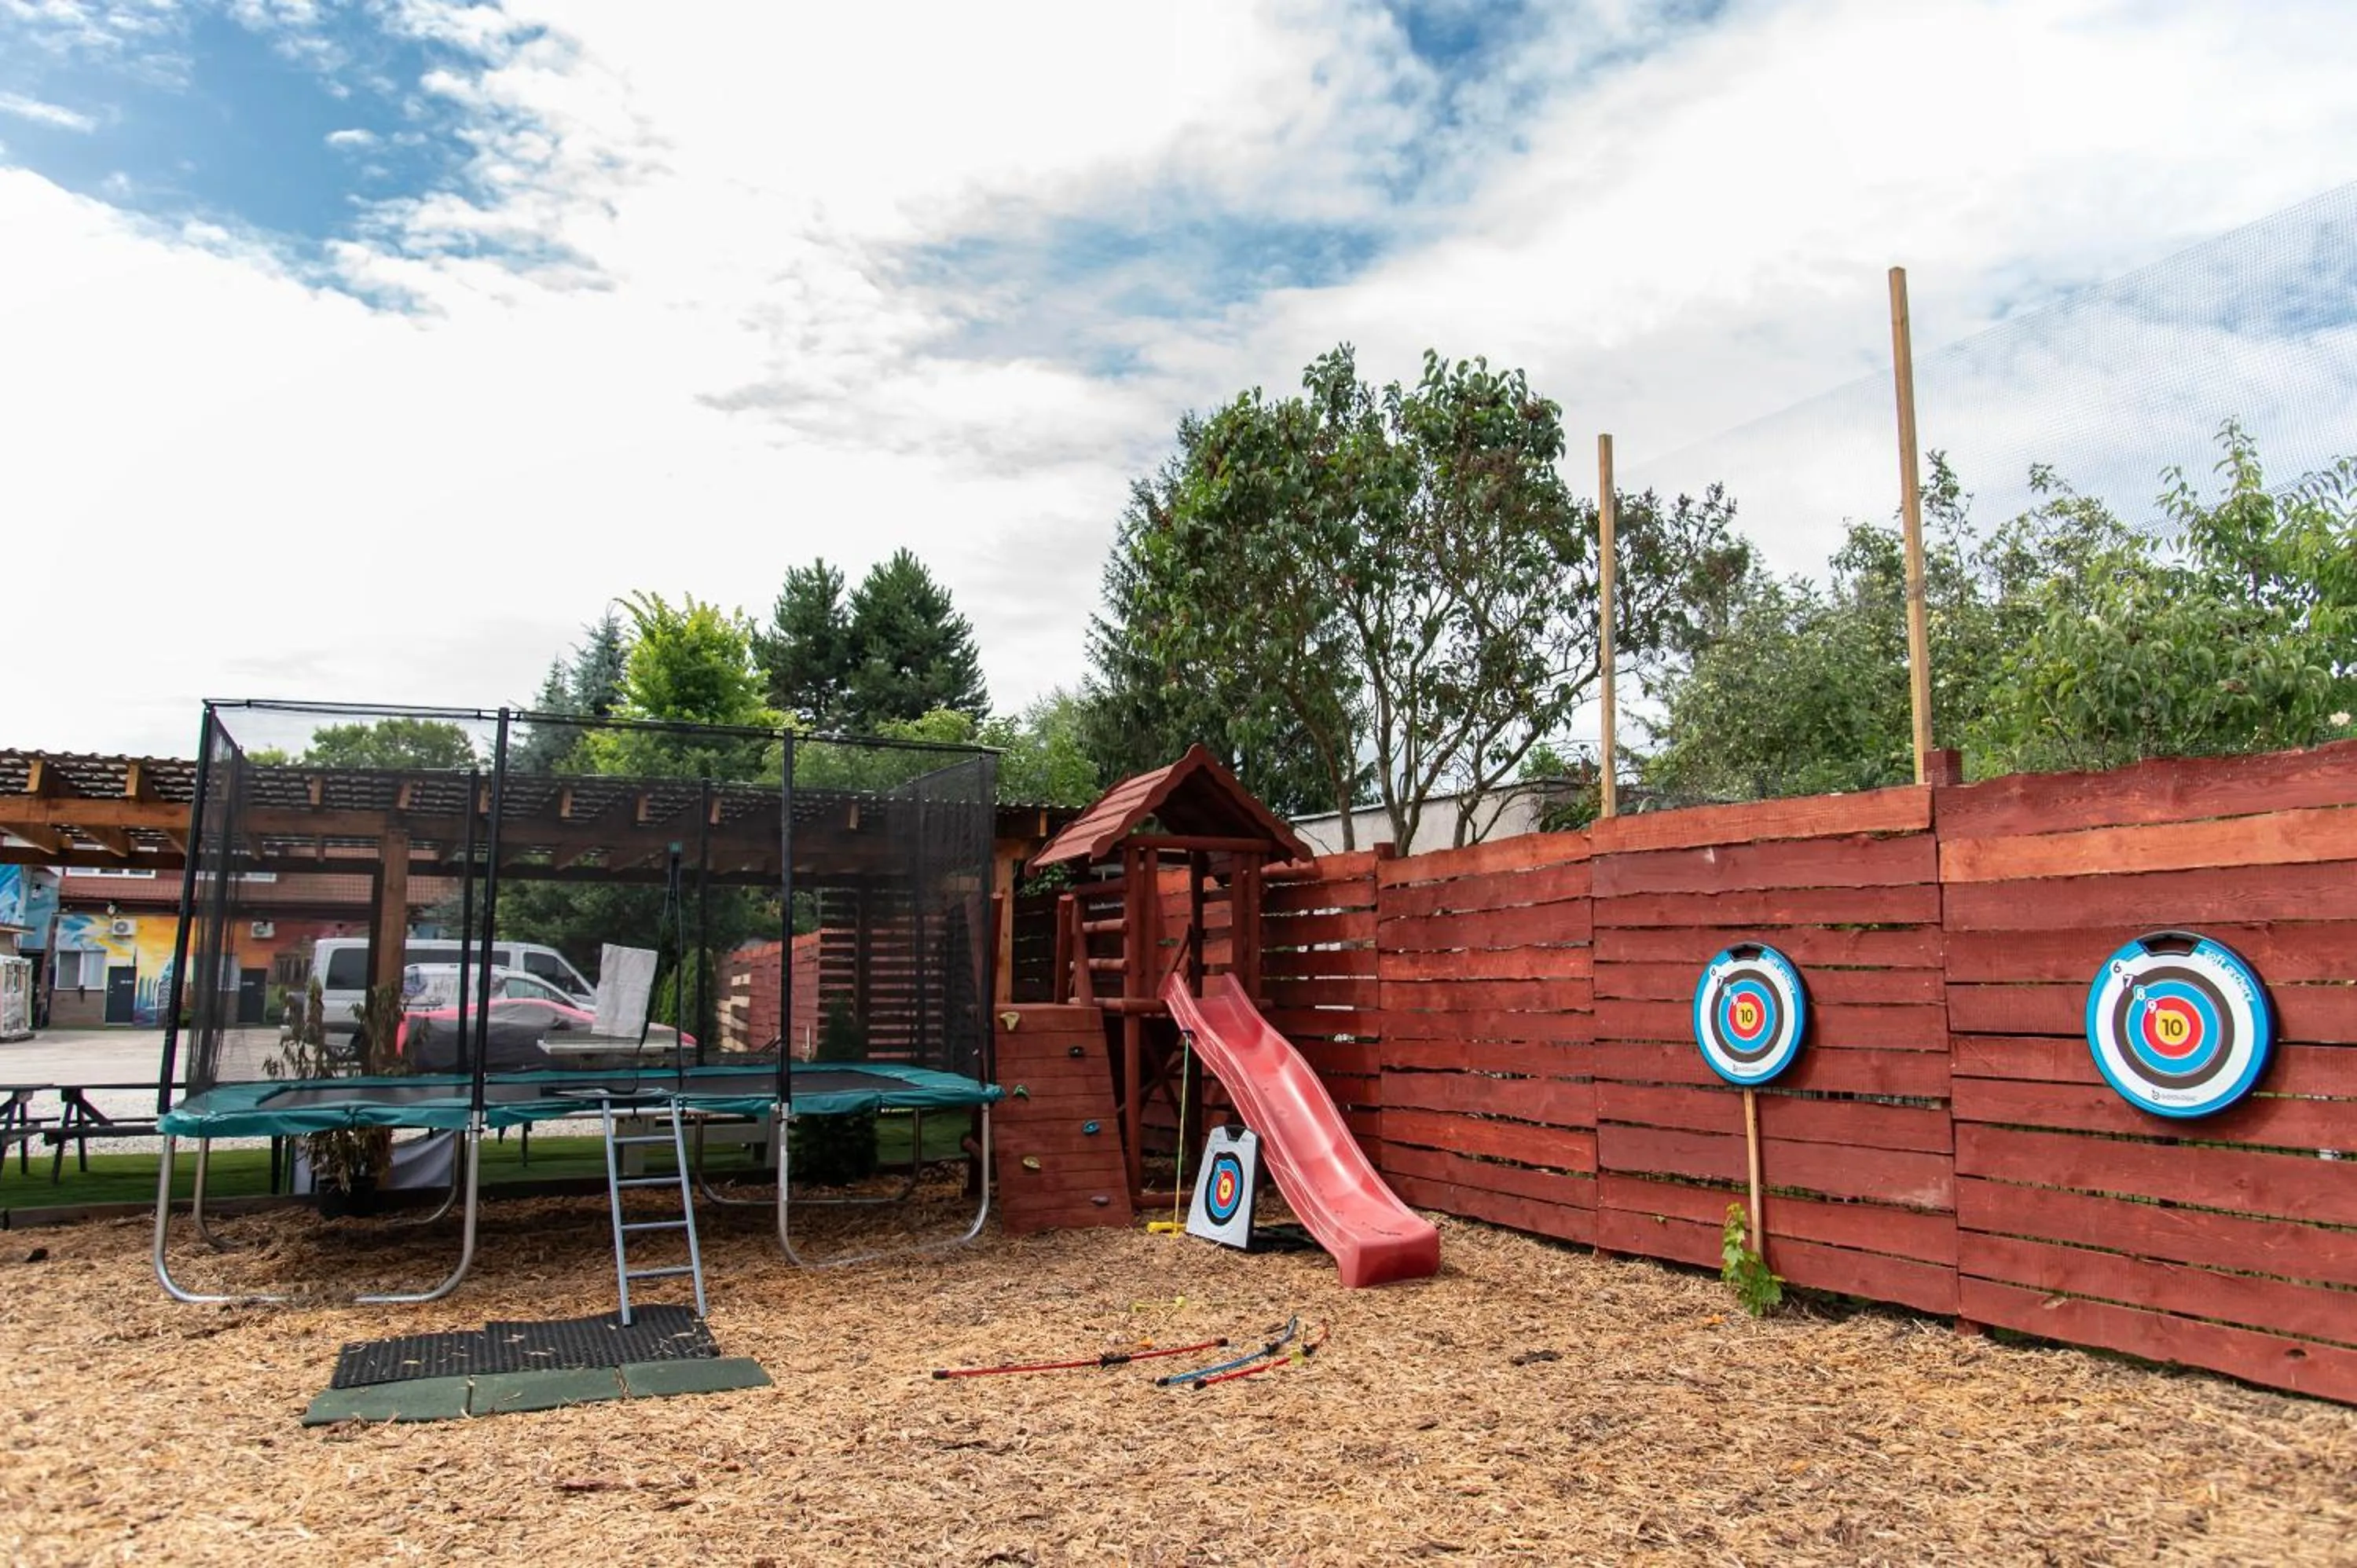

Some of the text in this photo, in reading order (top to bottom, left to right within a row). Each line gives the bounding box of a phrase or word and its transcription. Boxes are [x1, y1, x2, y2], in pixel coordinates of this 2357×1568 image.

[1710, 967, 1717, 976] 6
[2113, 961, 2122, 973] 6
[1717, 976, 1725, 987] 7
[2123, 974, 2134, 988] 7
[2136, 987, 2146, 1001] 8
[2147, 999, 2157, 1013] 9
[1739, 1009, 1754, 1024] 10
[2161, 1019, 2183, 1036] 10
